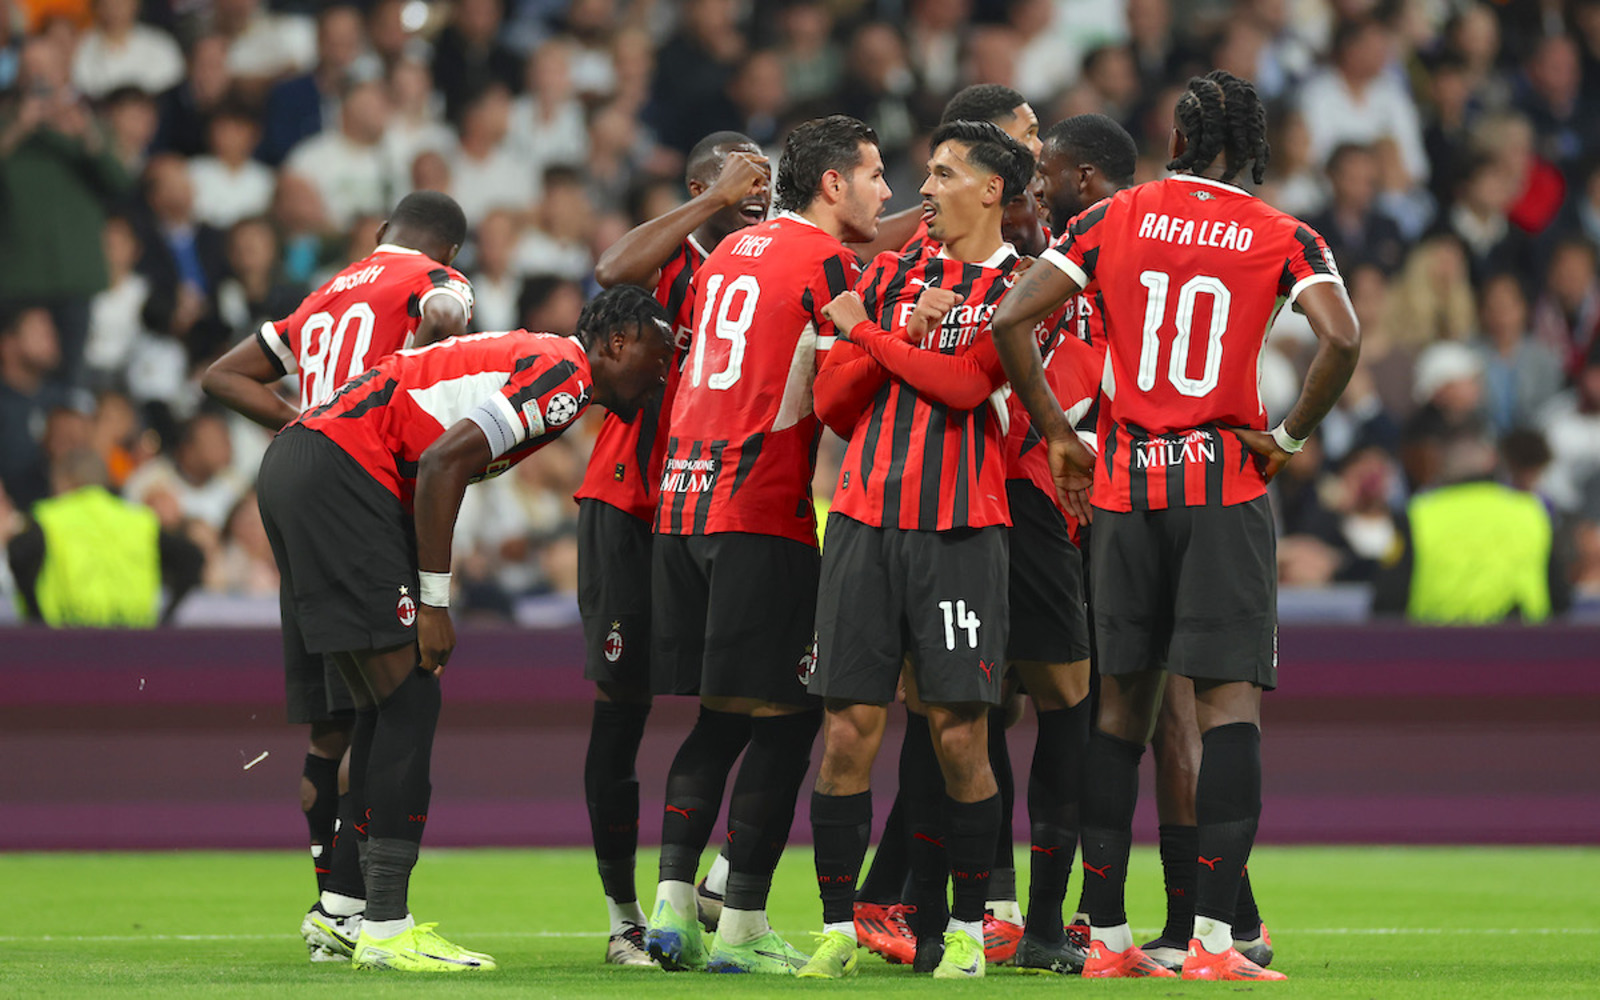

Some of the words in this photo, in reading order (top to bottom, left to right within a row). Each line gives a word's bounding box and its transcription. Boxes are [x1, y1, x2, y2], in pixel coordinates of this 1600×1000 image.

[731, 234, 773, 257] THEO
[1138, 212, 1195, 245] RAFA
[692, 274, 761, 391] 19
[1137, 270, 1231, 398] 10
[300, 302, 376, 414] 80
[1136, 442, 1216, 469] MILAN
[660, 472, 714, 493] MILAN
[938, 599, 981, 651] 14
